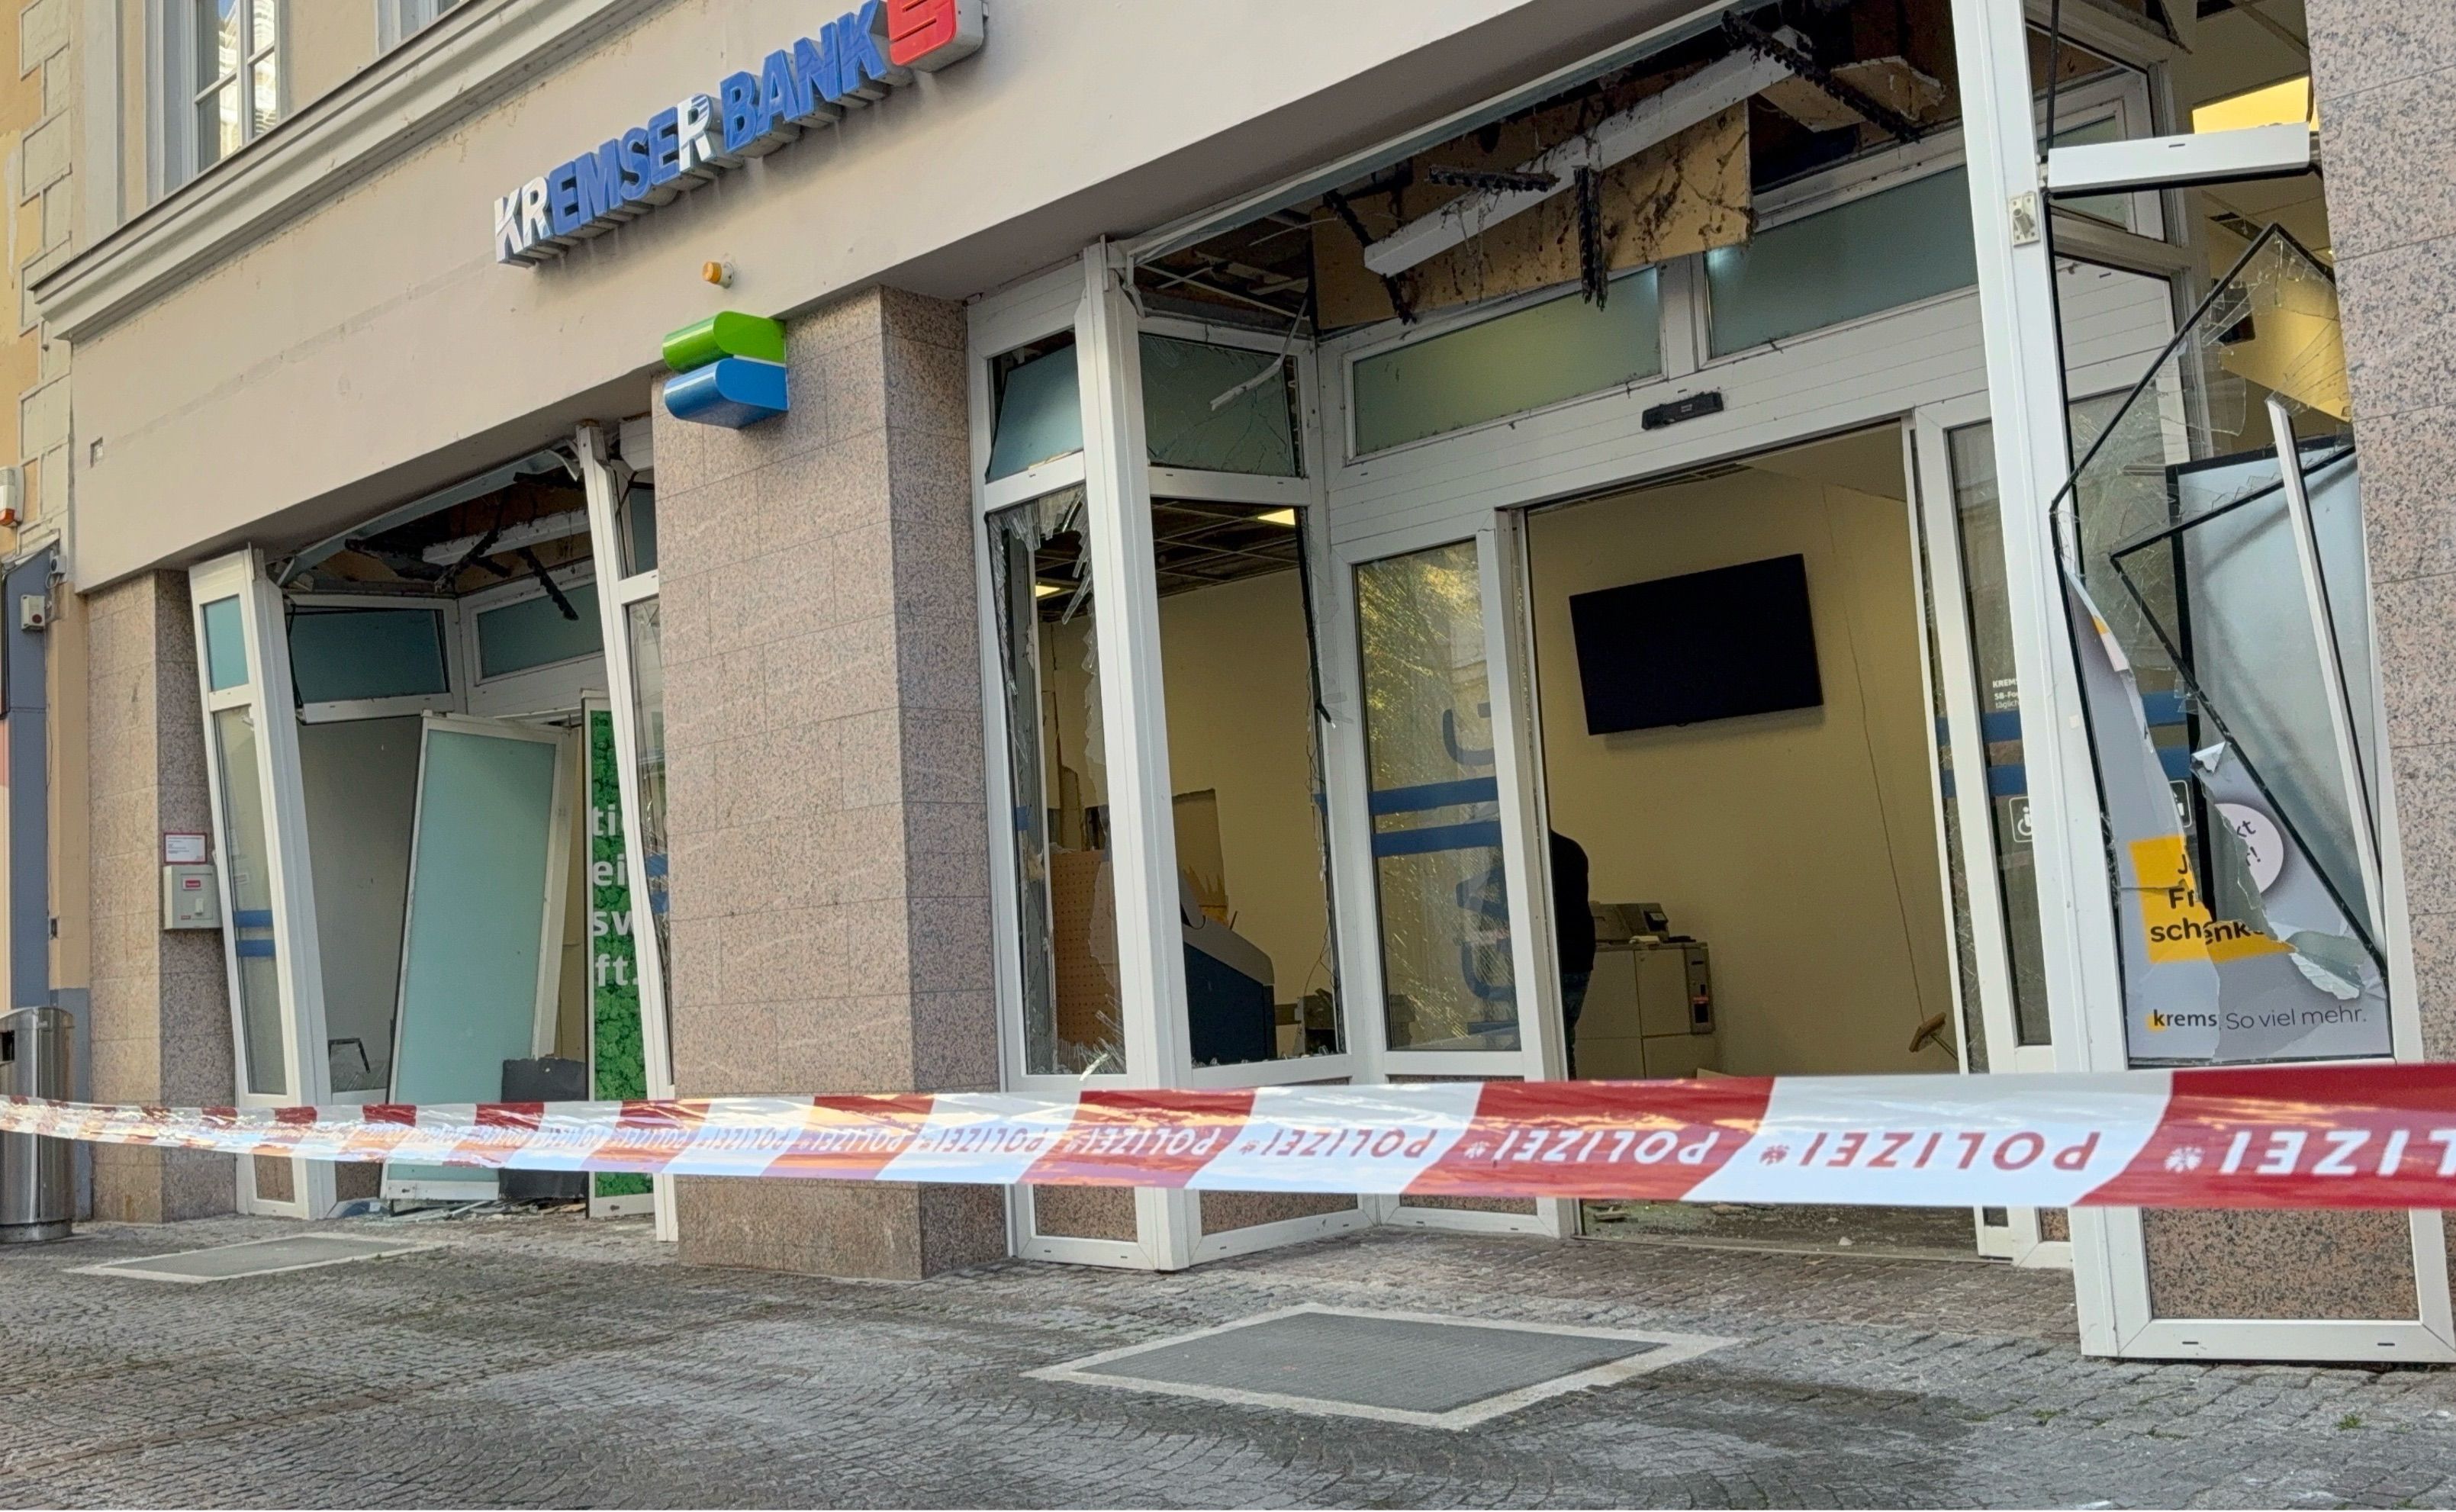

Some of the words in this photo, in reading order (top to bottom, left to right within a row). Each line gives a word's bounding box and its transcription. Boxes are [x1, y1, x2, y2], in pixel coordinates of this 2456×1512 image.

[494, 93, 713, 265] KREMSER
[719, 0, 887, 153] BANK
[1992, 677, 2017, 688] KREM
[593, 804, 623, 836] ti
[2226, 1012, 2255, 1030] So
[2258, 1008, 2296, 1028] viel
[2301, 1005, 2367, 1024] mehr.
[932, 1128, 1049, 1153] POLIZEI
[1078, 1128, 1221, 1155] POLIZEI
[1260, 1128, 1439, 1158] POLIZEI
[1492, 1129, 1720, 1165] POLIZEI
[1798, 1131, 2101, 1171] POLIZEI
